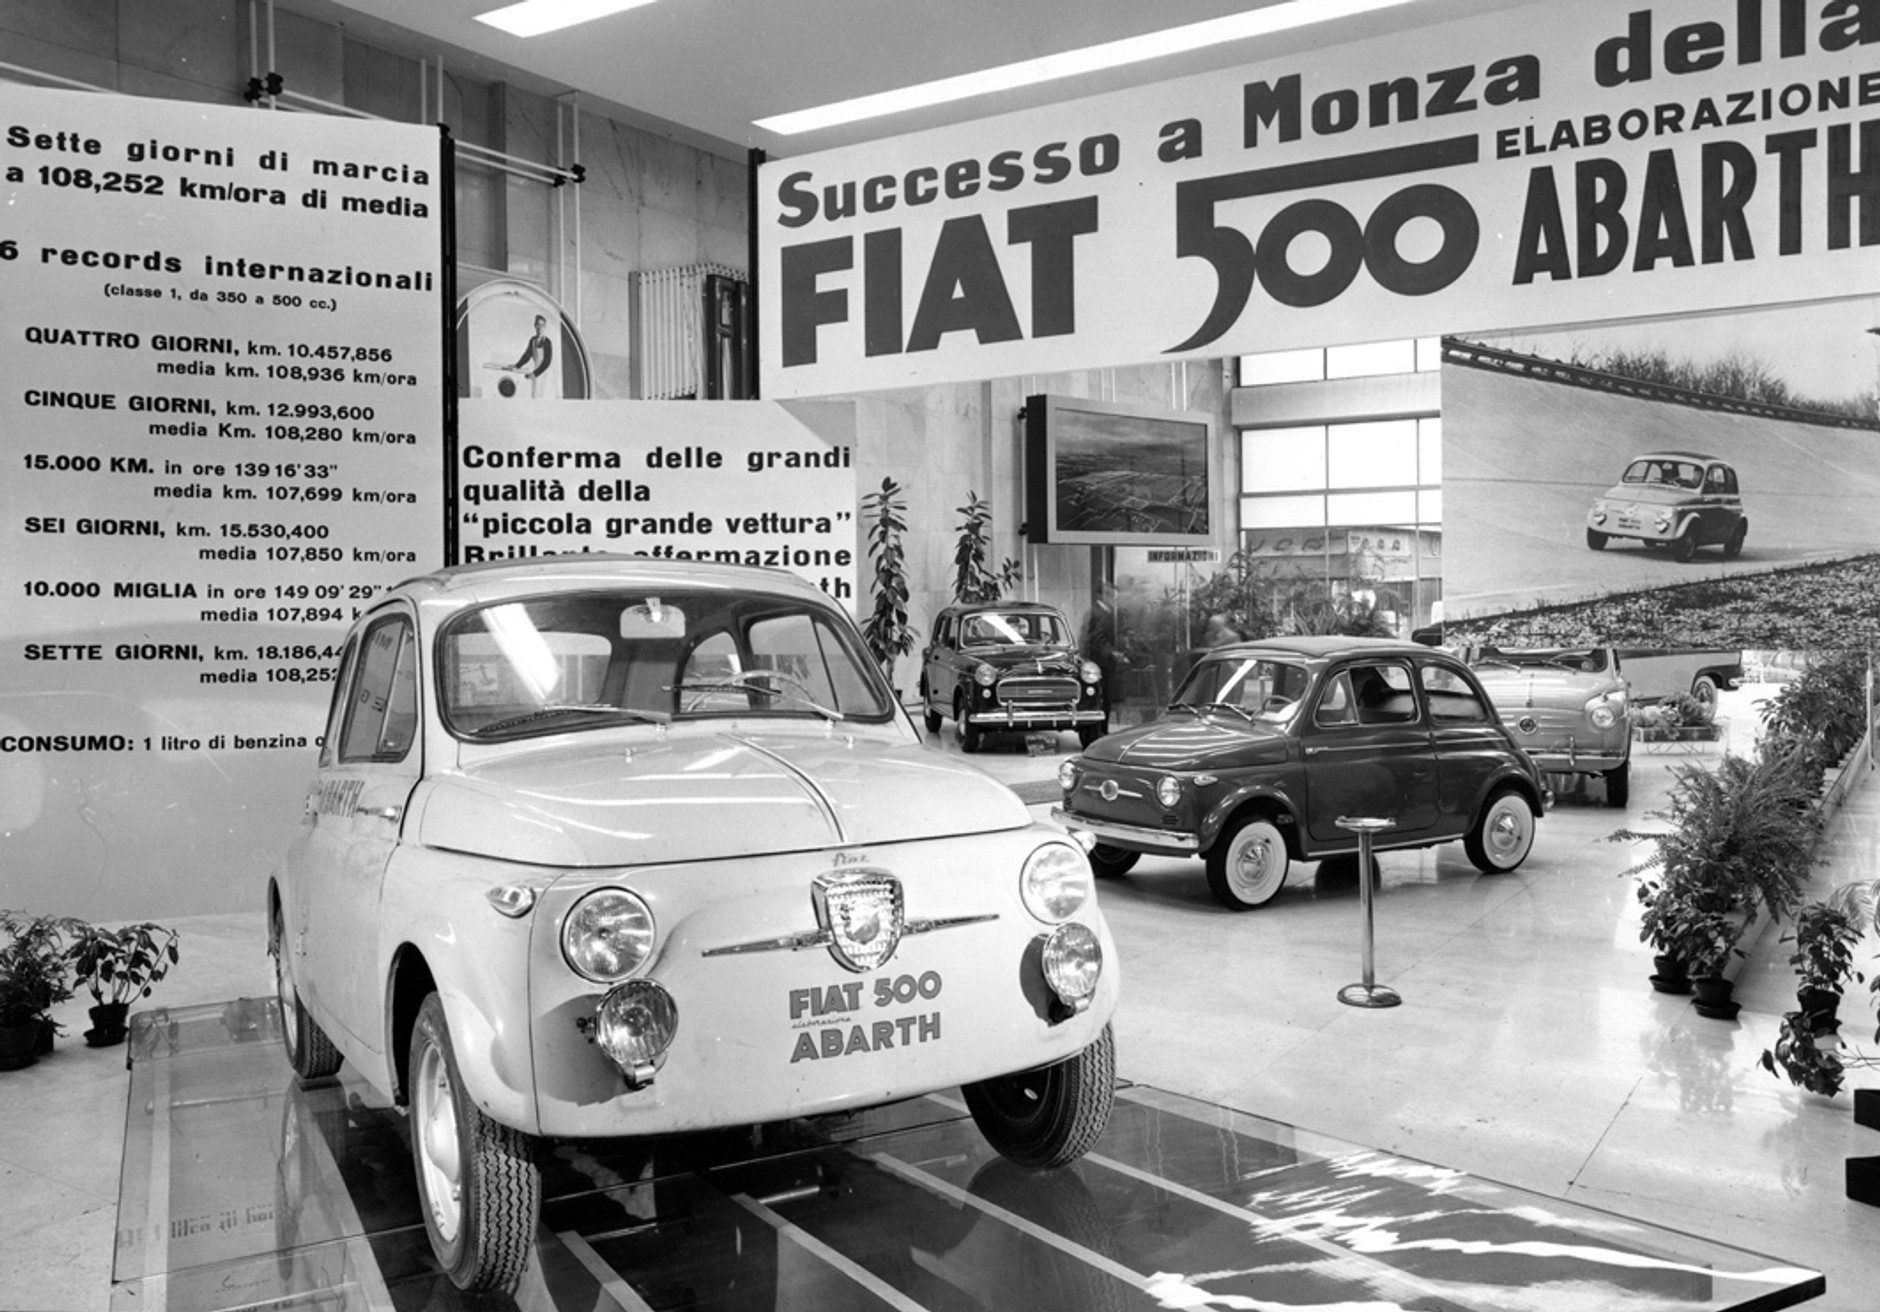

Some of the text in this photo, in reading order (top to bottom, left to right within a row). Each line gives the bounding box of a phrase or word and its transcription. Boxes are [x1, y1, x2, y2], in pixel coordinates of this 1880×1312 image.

[777, 0, 1880, 229] Successo a Monza della
[1497, 70, 1880, 160] ELABORAZIONE
[7, 126, 428, 185] Sette giorni di marcia
[6, 166, 428, 218] a 108,252 km/ora di media
[781, 117, 1880, 368] FIAT 500 ABARTH
[0, 240, 432, 291] 6 records internazionali
[105, 283, 162, 298] (classe
[190, 289, 208, 301] da
[217, 291, 247, 303] 350
[255, 296, 264, 304] a
[273, 295, 301, 307] 500
[310, 299, 336, 312] cc.)
[26, 327, 392, 362] QUATTRO GIORNI, km. 10.457,856
[158, 361, 416, 385] media km. 108,936 km/ora
[25, 390, 374, 420] CINQUE GIORNI, km. 12.993,600
[149, 422, 416, 444] media Km. 108,280 km/ora
[24, 455, 100, 471] 15.000
[111, 457, 153, 473] KM.
[165, 460, 181, 474] in
[193, 465, 225, 476] ore
[463, 445, 850, 472] Conferma delle grandi
[154, 484, 416, 503] media km. 107,699 km/ora
[464, 480, 650, 505] qualità della
[25, 517, 328, 539] SEI GIORNI, km. 15.530,400
[606, 512, 712, 538] grande
[200, 546, 416, 562] media 107,850 km/ora
[25, 581, 100, 597] 10.000
[114, 583, 197, 598] MIGLIA
[208, 584, 224, 598] in
[234, 588, 266, 598] ore
[201, 608, 257, 621] media
[268, 608, 343, 622] 107,894
[24, 644, 102, 660] SETTE
[116, 644, 203, 662] GIORNI,
[215, 646, 248, 660] km.
[200, 669, 257, 683] media
[0, 735, 133, 752] CONSUMO:
[144, 738, 150, 750] 1
[162, 736, 200, 750] litro
[209, 735, 225, 749] di
[234, 734, 306, 749] benzina
[789, 970, 942, 1019] FIAT 500
[790, 1012, 940, 1063] ABARTH
